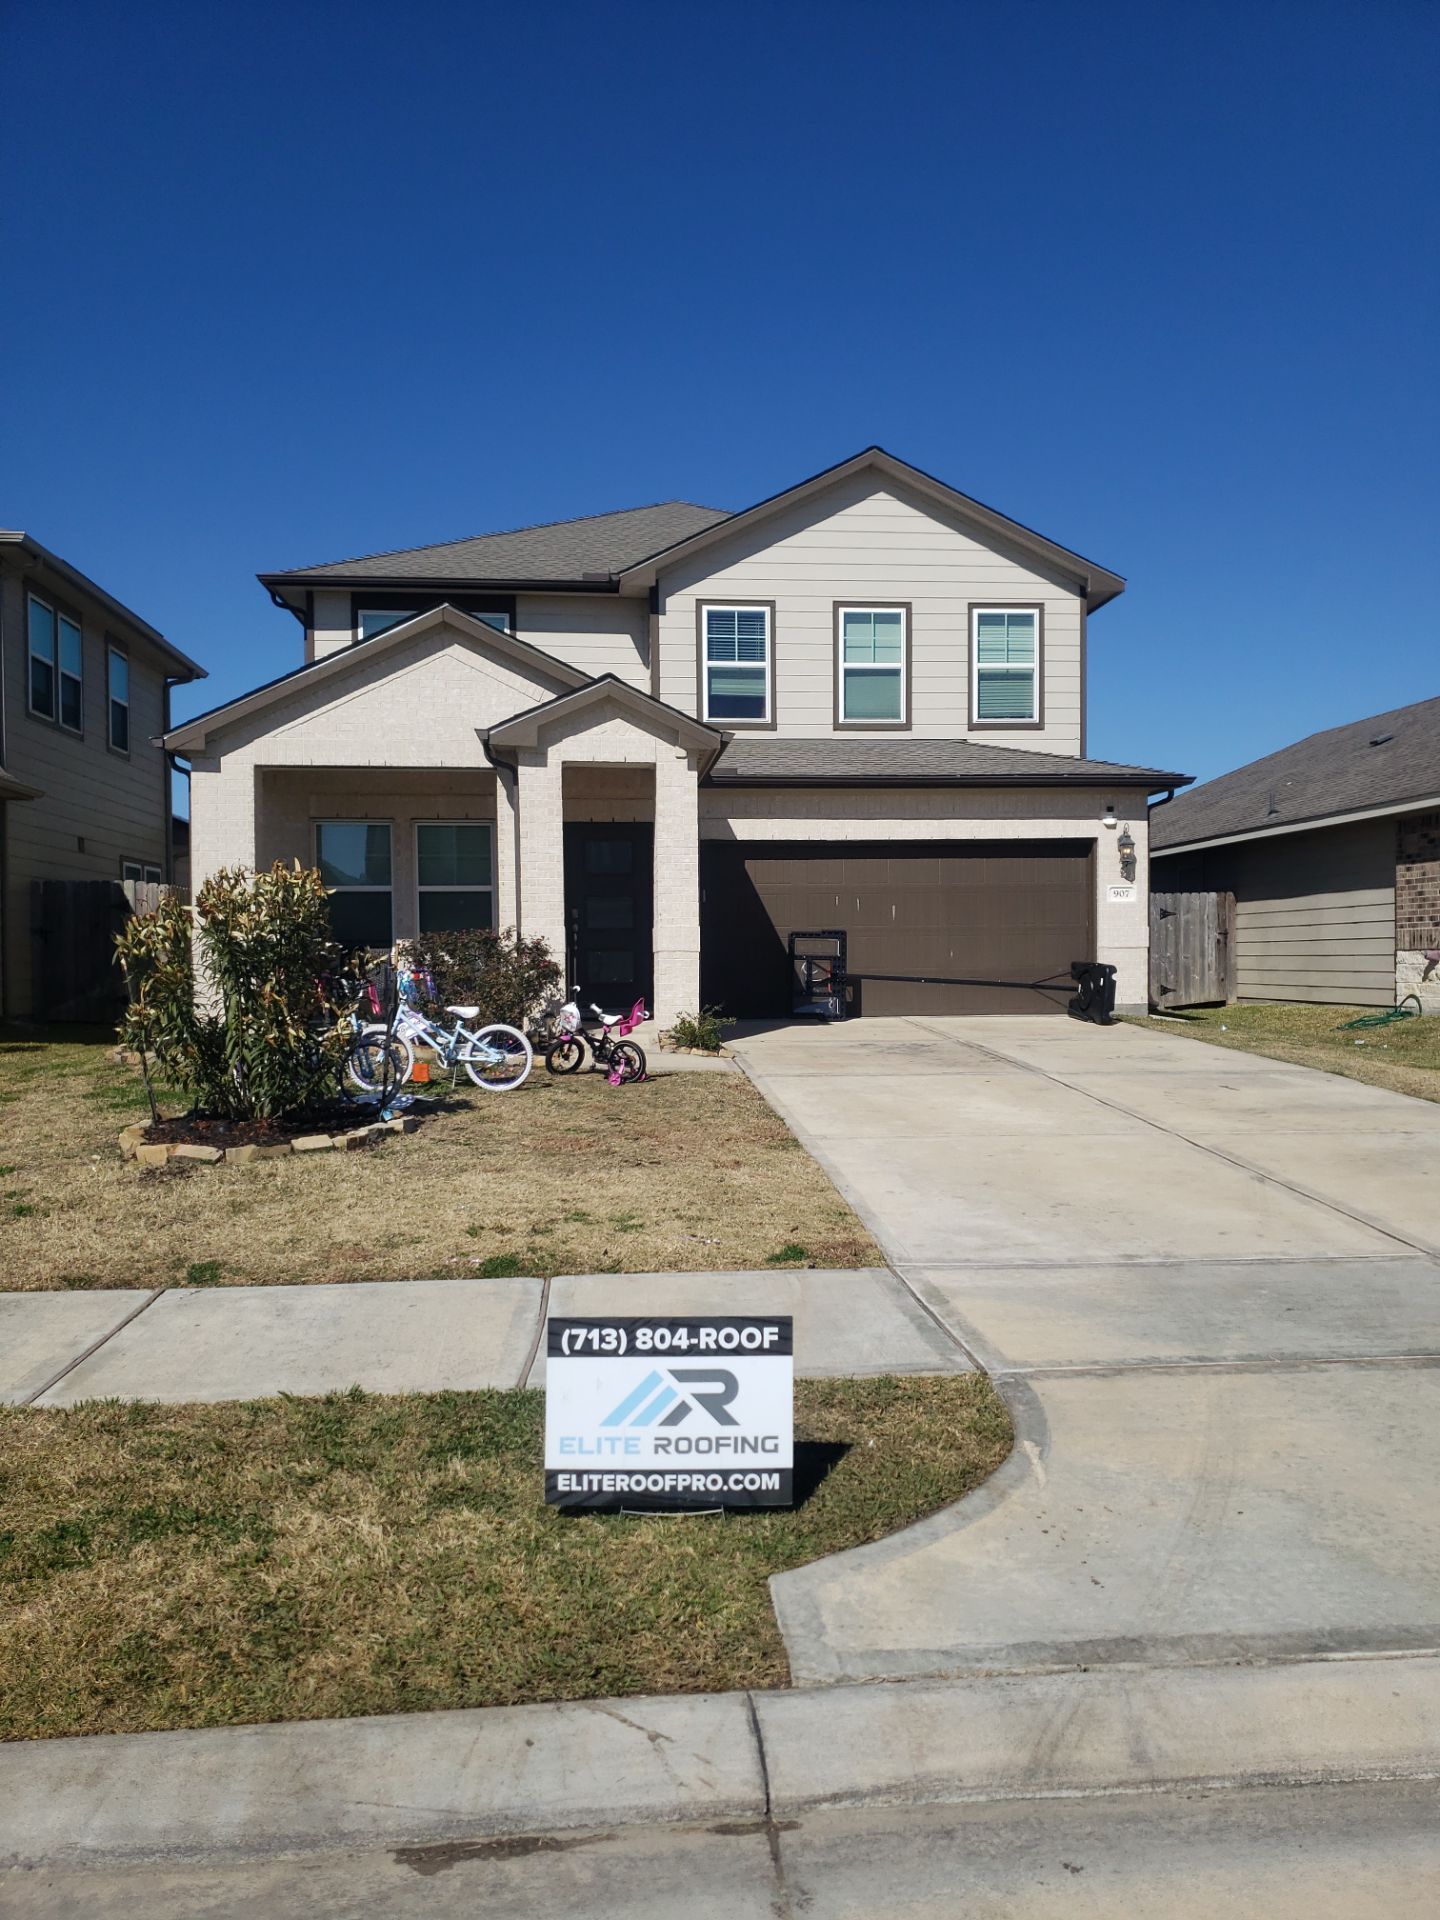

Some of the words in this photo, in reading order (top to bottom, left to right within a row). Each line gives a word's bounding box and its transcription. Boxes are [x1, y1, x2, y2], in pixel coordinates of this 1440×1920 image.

[1113, 889, 1130, 898] 907
[561, 1328, 627, 1355] (713)
[635, 1327, 779, 1350] 804-ROOF
[559, 1436, 641, 1455] ELITE
[654, 1435, 779, 1455] ROOFING
[557, 1473, 780, 1492] ELITEROOFPRO.COM
